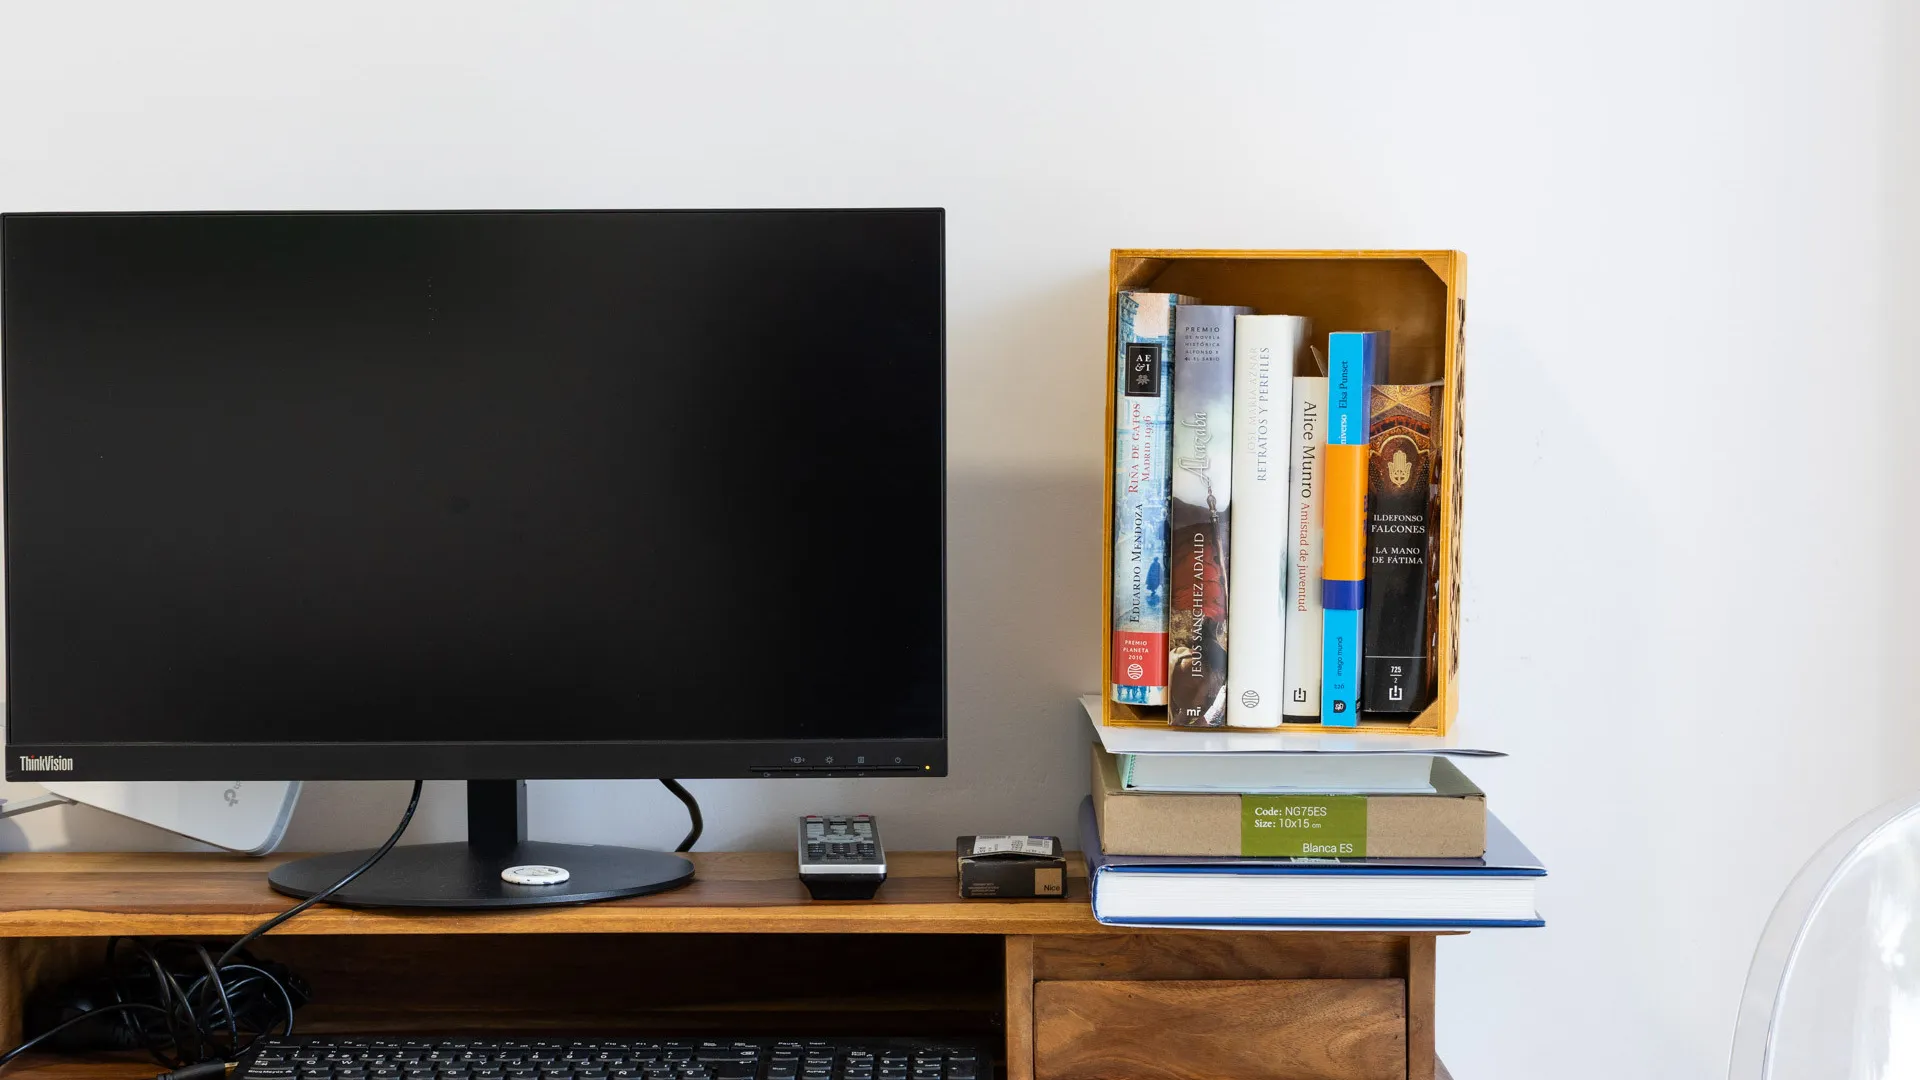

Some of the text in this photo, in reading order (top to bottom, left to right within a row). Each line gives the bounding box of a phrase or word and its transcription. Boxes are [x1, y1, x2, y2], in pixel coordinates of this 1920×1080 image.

[1338, 360, 1348, 409] Elsa Punset
[1257, 347, 1269, 481] RETRATOS Y PERFILES
[1338, 414, 1348, 445] niverso
[1128, 403, 1141, 493] RIÑA DE GATOS
[1301, 401, 1317, 498] Alice Munro
[1373, 514, 1424, 522] ILDEFONSO
[1371, 524, 1425, 534] FALCONES
[1193, 533, 1205, 582] ADALID
[1297, 502, 1310, 612] Amistad de juventud
[1375, 547, 1420, 555] LA MANO
[1130, 503, 1143, 623] EDUARDO MENDOZA
[1371, 555, 1424, 565] DE FÁTIMA
[20, 755, 73, 772] ThinkVision
[1254, 806, 1327, 817] Code: NG75ES
[1254, 819, 1276, 829] Size:
[1279, 818, 1310, 829] 10x15
[1302, 843, 1353, 853] Blanca ES
[1043, 884, 1060, 892] Nice
